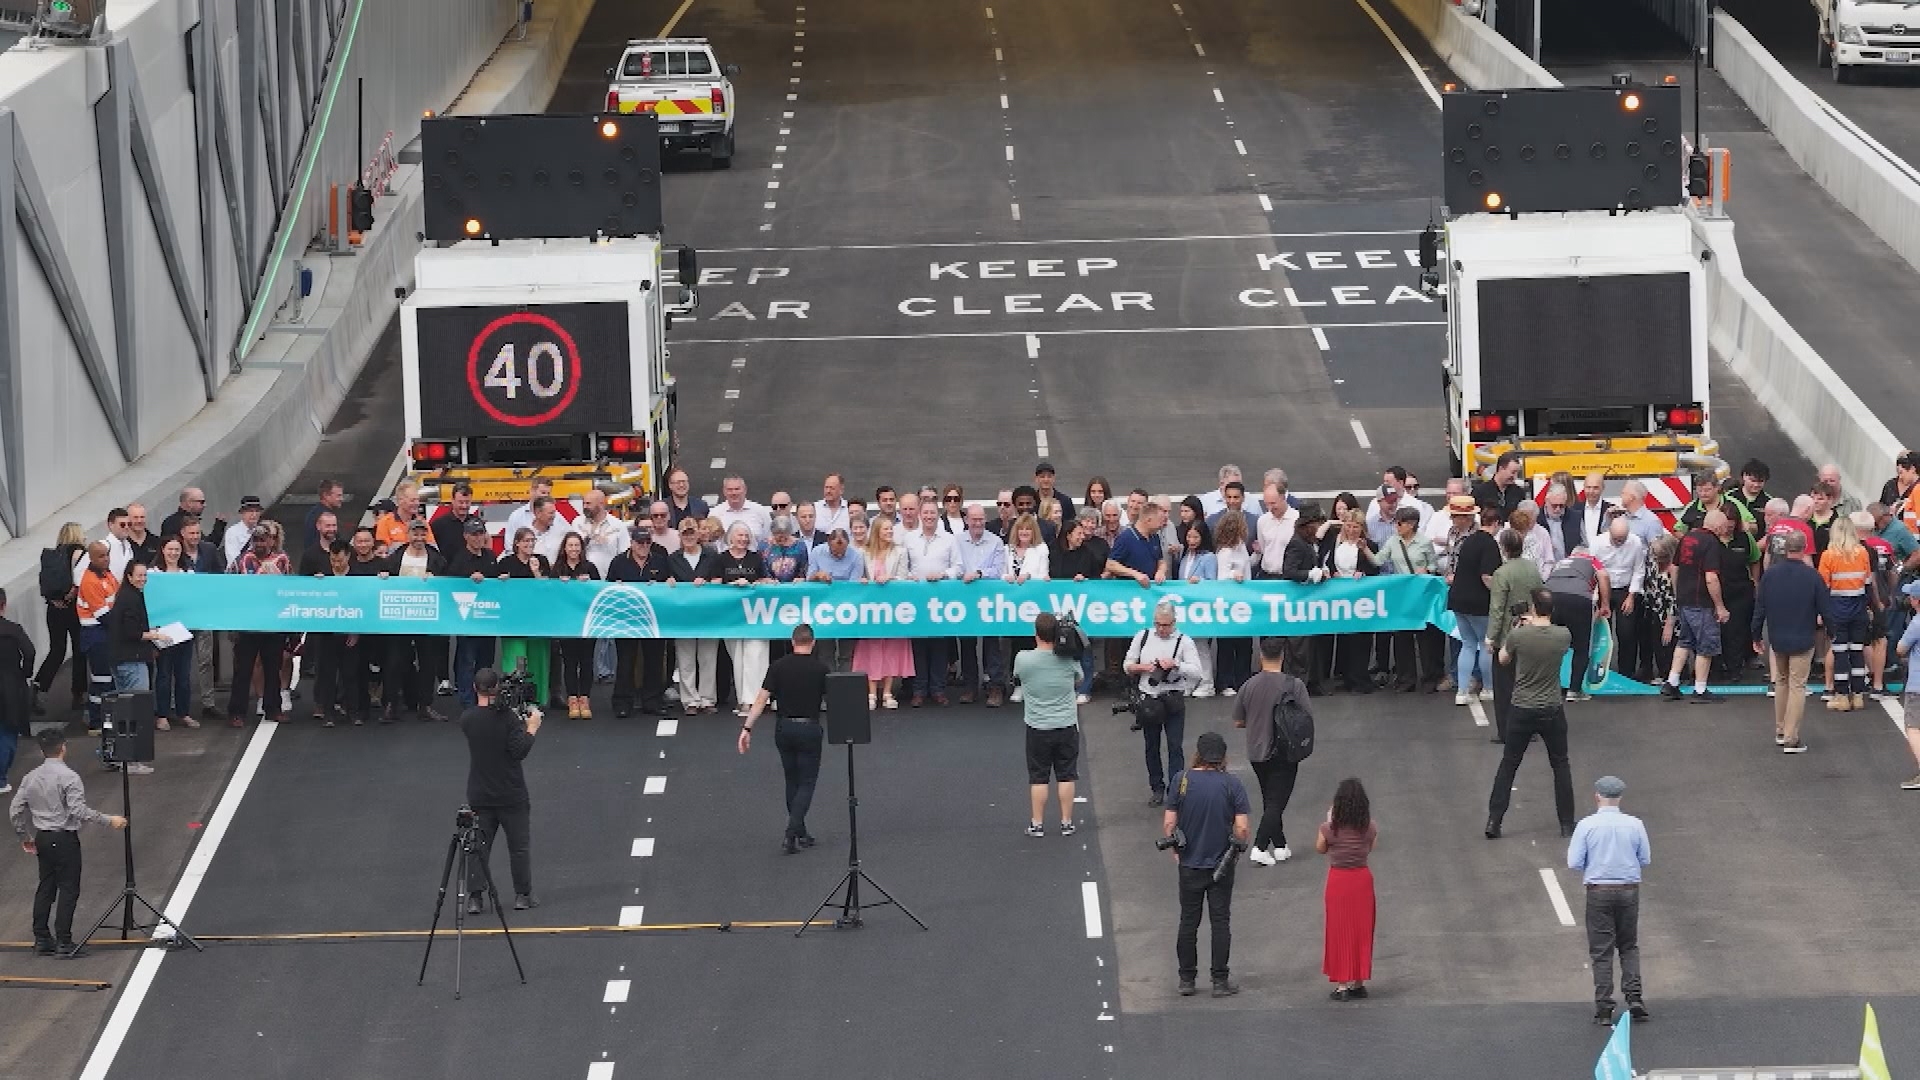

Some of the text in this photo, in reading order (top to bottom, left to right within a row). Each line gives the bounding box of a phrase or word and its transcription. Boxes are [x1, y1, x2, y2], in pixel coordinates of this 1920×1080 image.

[930, 257, 1118, 280] KEEP
[898, 291, 1155, 316] CLEAR
[1238, 284, 1447, 307] CLEA
[483, 341, 564, 398] 40
[383, 595, 435, 603] VICTORIA'S
[741, 596, 917, 625] Welcome
[927, 596, 966, 623] to
[977, 594, 1042, 623] the
[1050, 593, 1146, 623] West
[1261, 589, 1389, 622] Tunnel
[288, 603, 363, 619] Transurban
[383, 607, 435, 616] BIG BUILD
